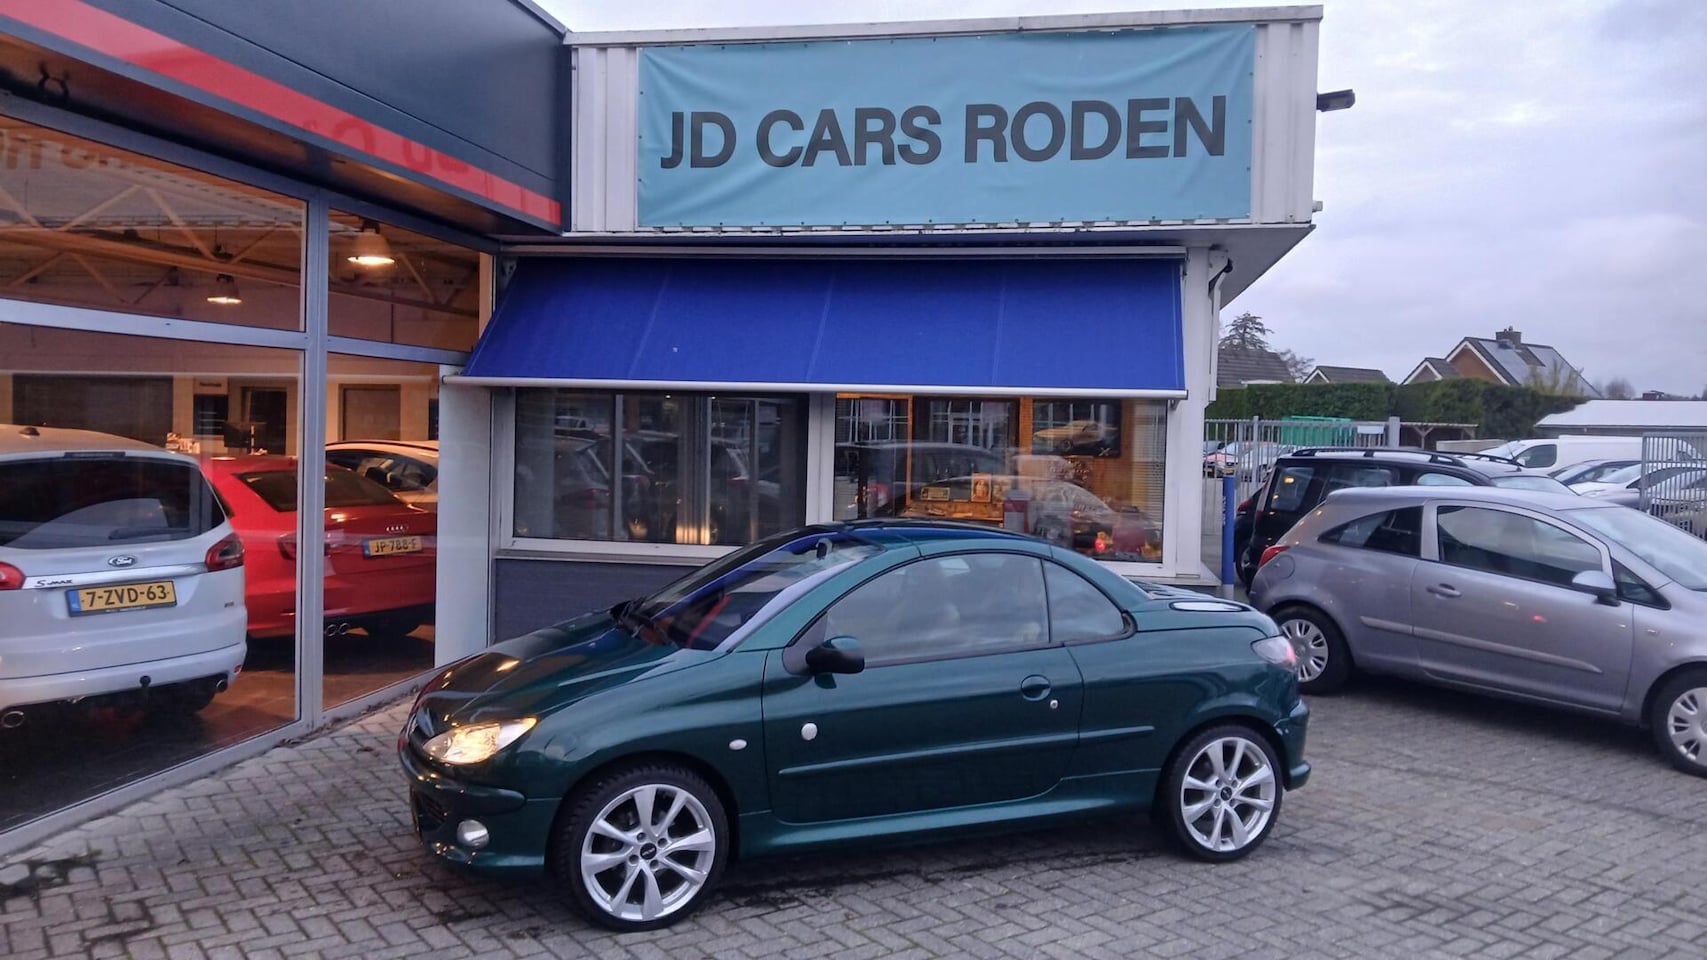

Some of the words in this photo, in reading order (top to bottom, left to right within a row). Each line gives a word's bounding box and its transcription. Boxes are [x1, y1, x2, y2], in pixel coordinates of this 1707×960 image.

[660, 111, 737, 169] JD
[756, 105, 942, 168] CARS
[965, 95, 1227, 164] RODEN
[85, 585, 168, 607] 7-ZVD-63
